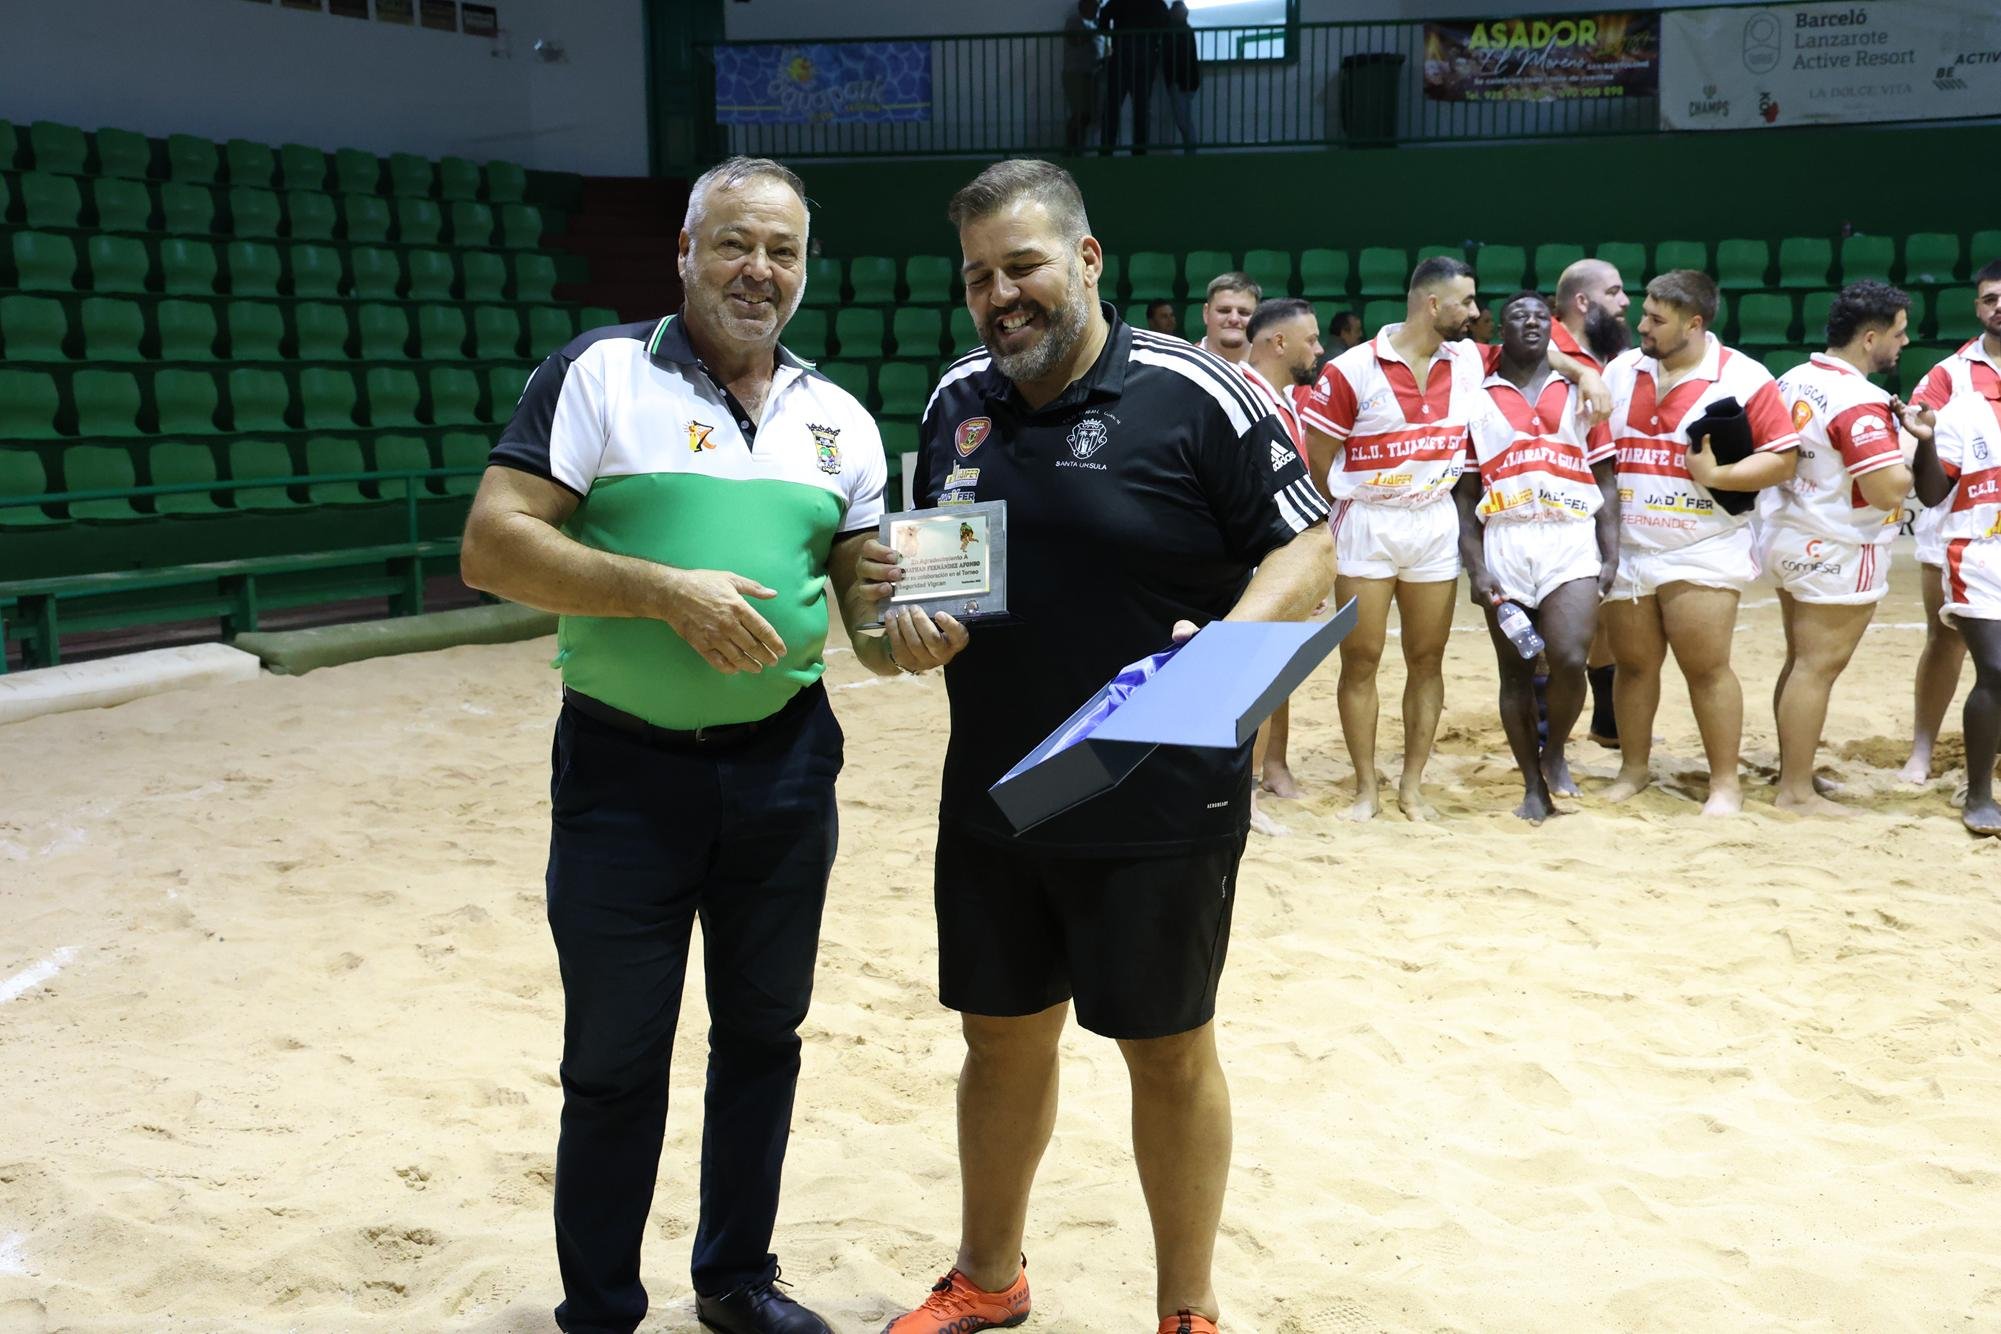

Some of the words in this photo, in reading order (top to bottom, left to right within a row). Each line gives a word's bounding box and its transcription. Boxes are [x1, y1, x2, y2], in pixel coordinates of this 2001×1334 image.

[1796, 9, 1867, 28] Barceló
[1468, 19, 1598, 50] ASADOR
[1794, 30, 1888, 49] Lanzarote
[1793, 51, 1849, 69] Active
[1856, 49, 1915, 67] Resort
[1936, 67, 1955, 79] BE
[1882, 84, 1912, 96] VITA
[1272, 451, 1296, 472] adidas
[1621, 514, 1697, 531] FERNANDEZ
